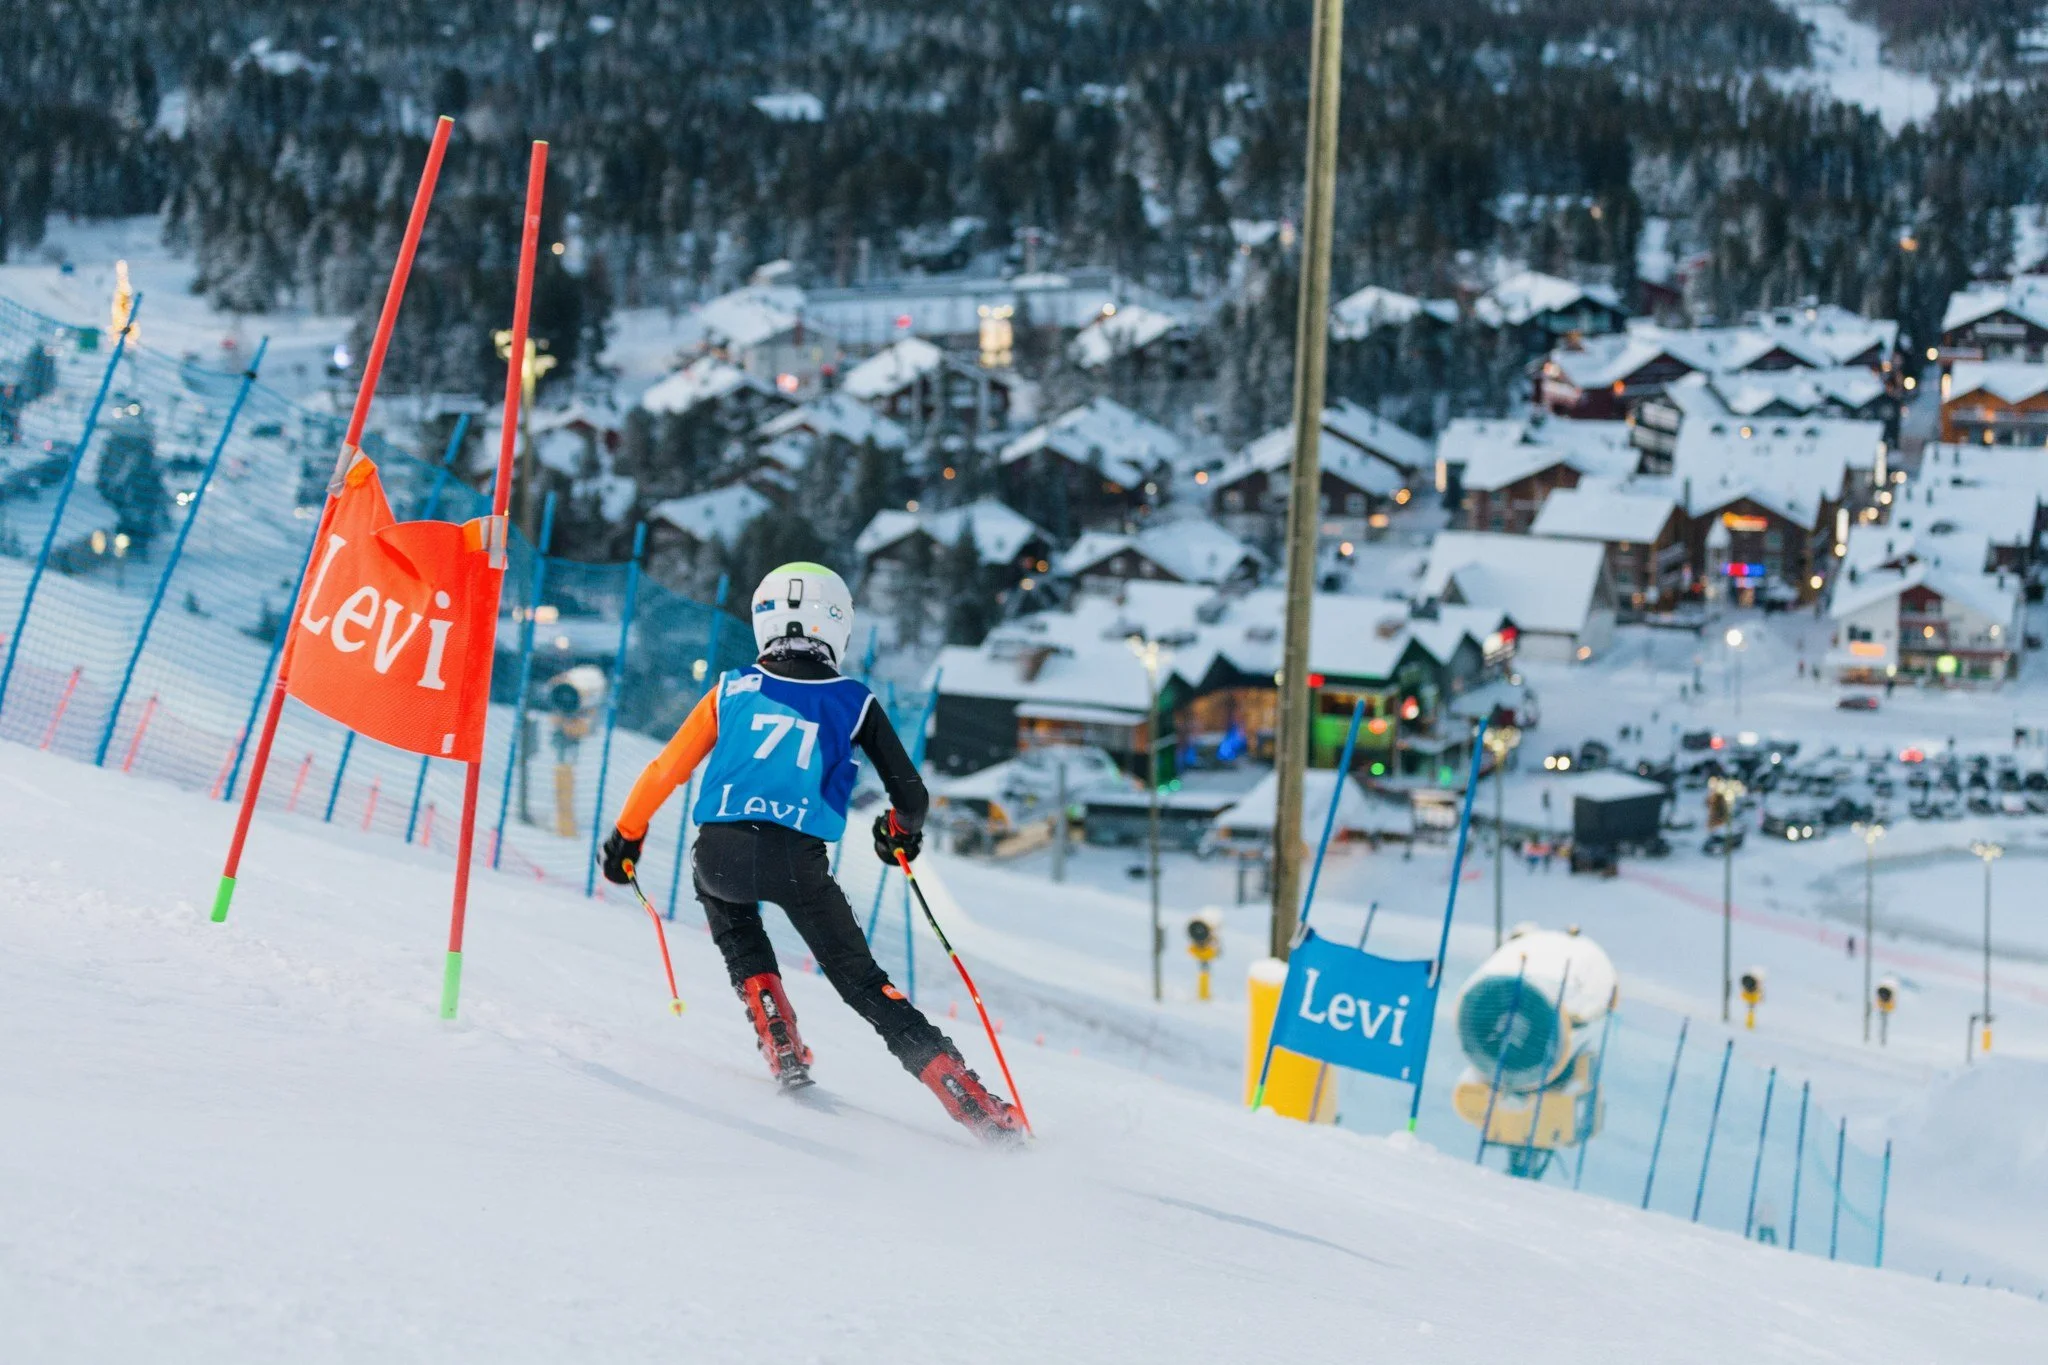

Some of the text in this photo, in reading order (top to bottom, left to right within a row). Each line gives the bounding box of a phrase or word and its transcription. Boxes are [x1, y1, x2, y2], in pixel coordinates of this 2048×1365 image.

[300, 534, 453, 690] Levi
[716, 783, 809, 831] Levi
[1299, 968, 1410, 1046] Levi
